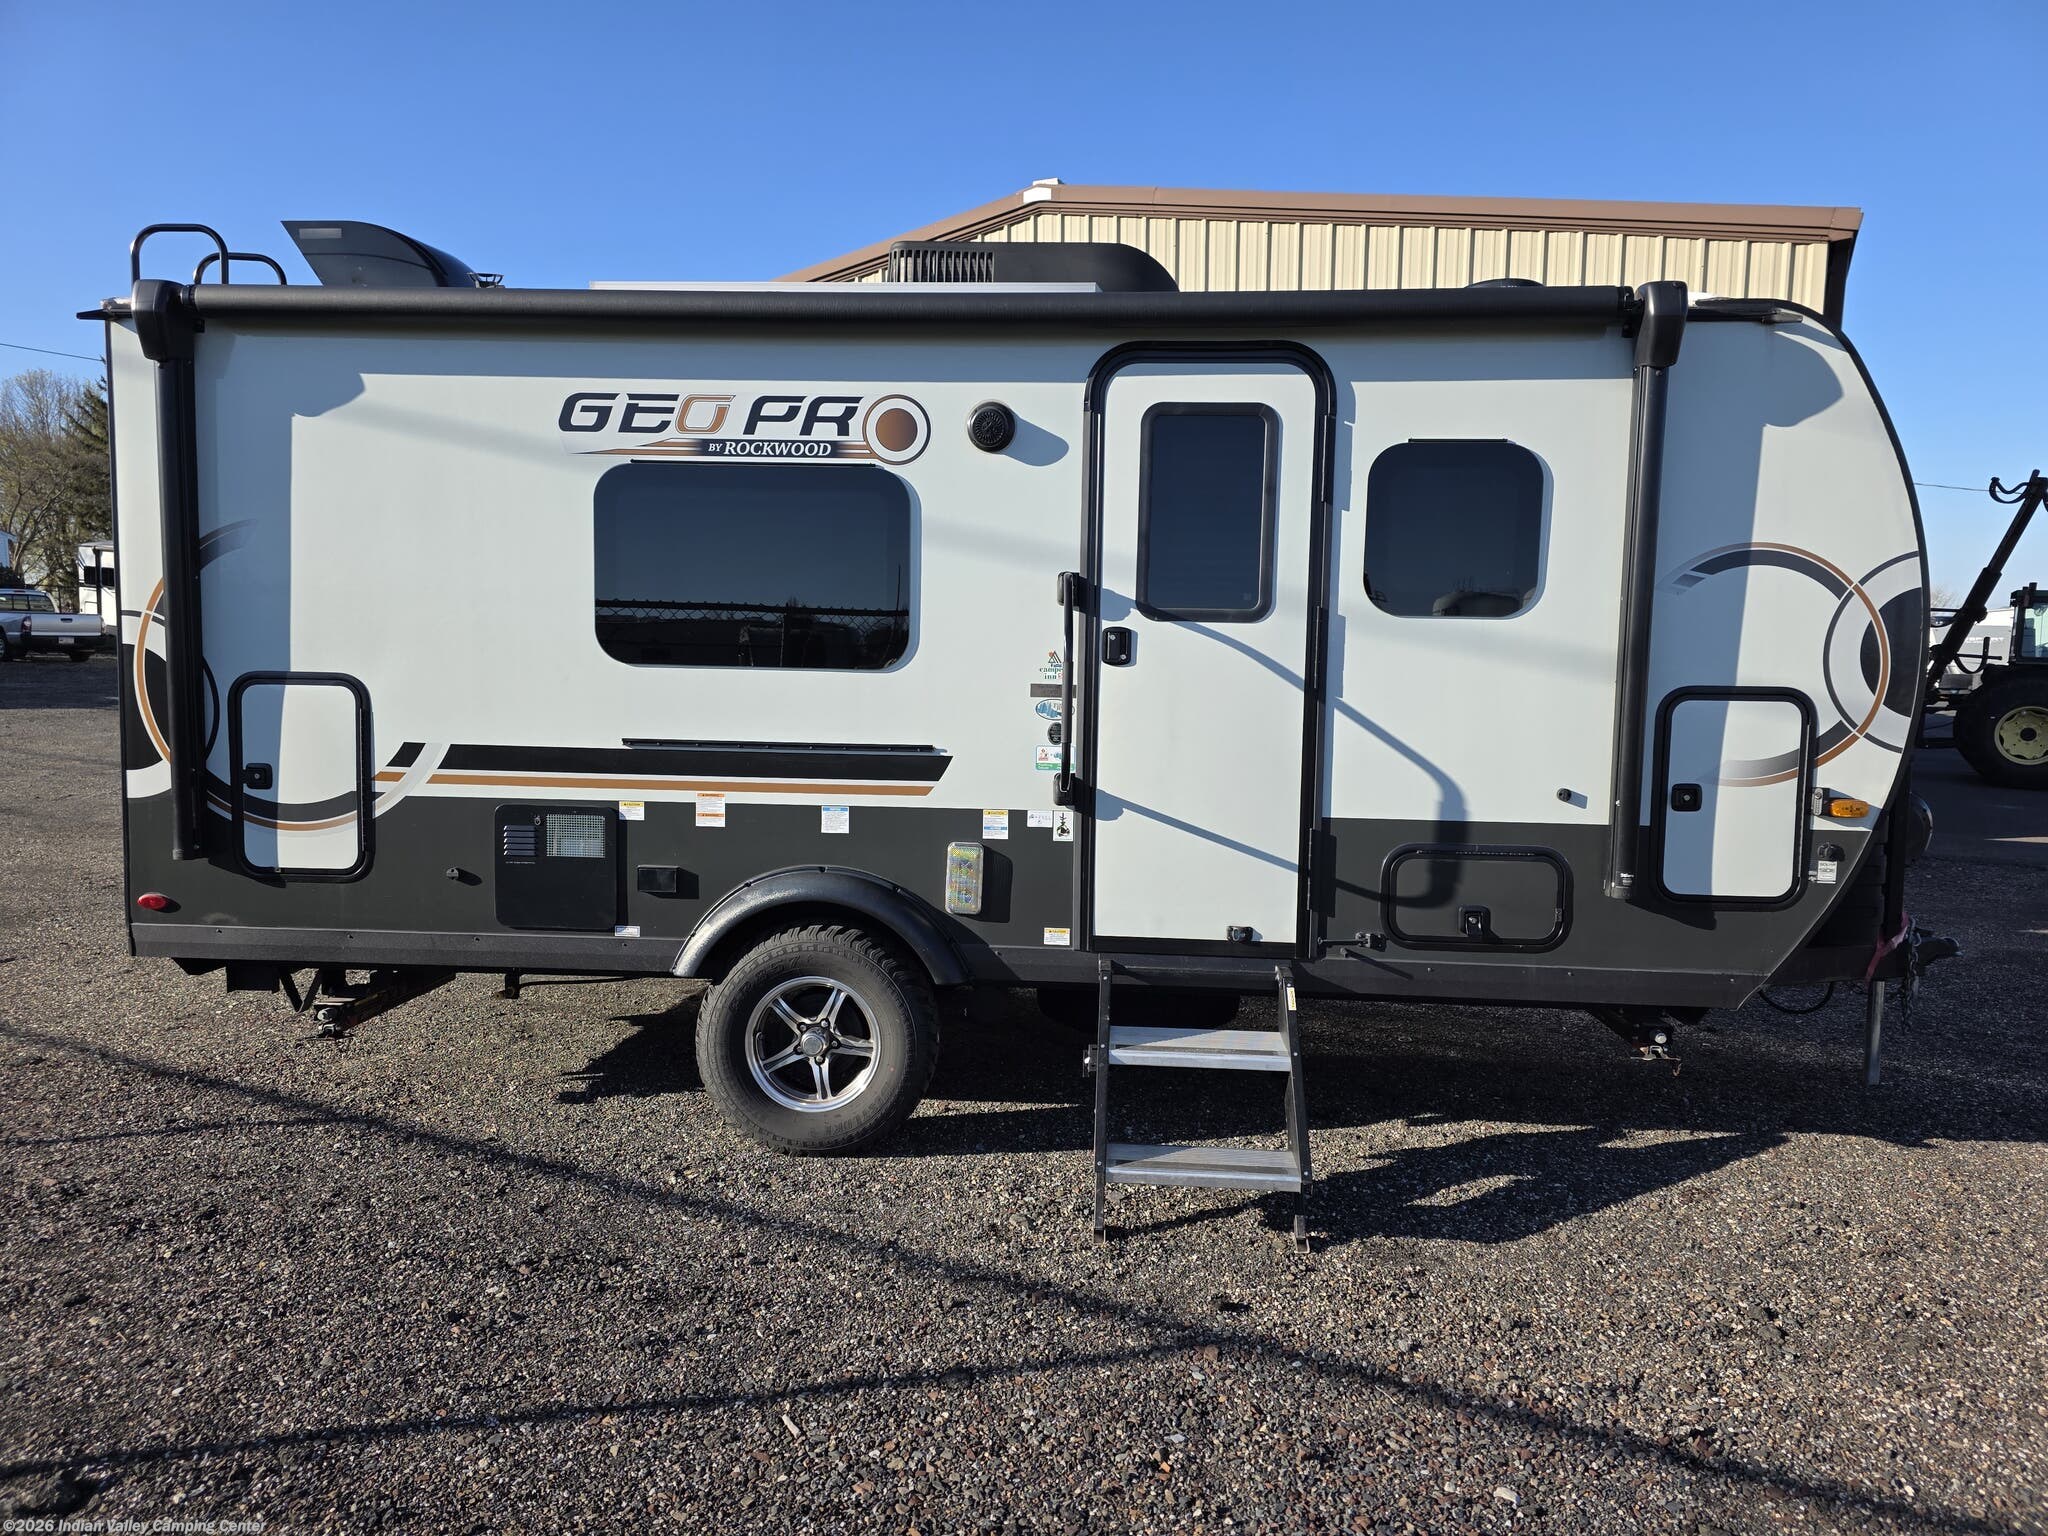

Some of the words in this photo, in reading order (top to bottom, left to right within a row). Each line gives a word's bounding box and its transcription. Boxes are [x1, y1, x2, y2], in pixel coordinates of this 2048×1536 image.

[559, 392, 736, 434] GEO
[708, 442, 723, 452] BY
[723, 440, 833, 457] ROCKWOOD
